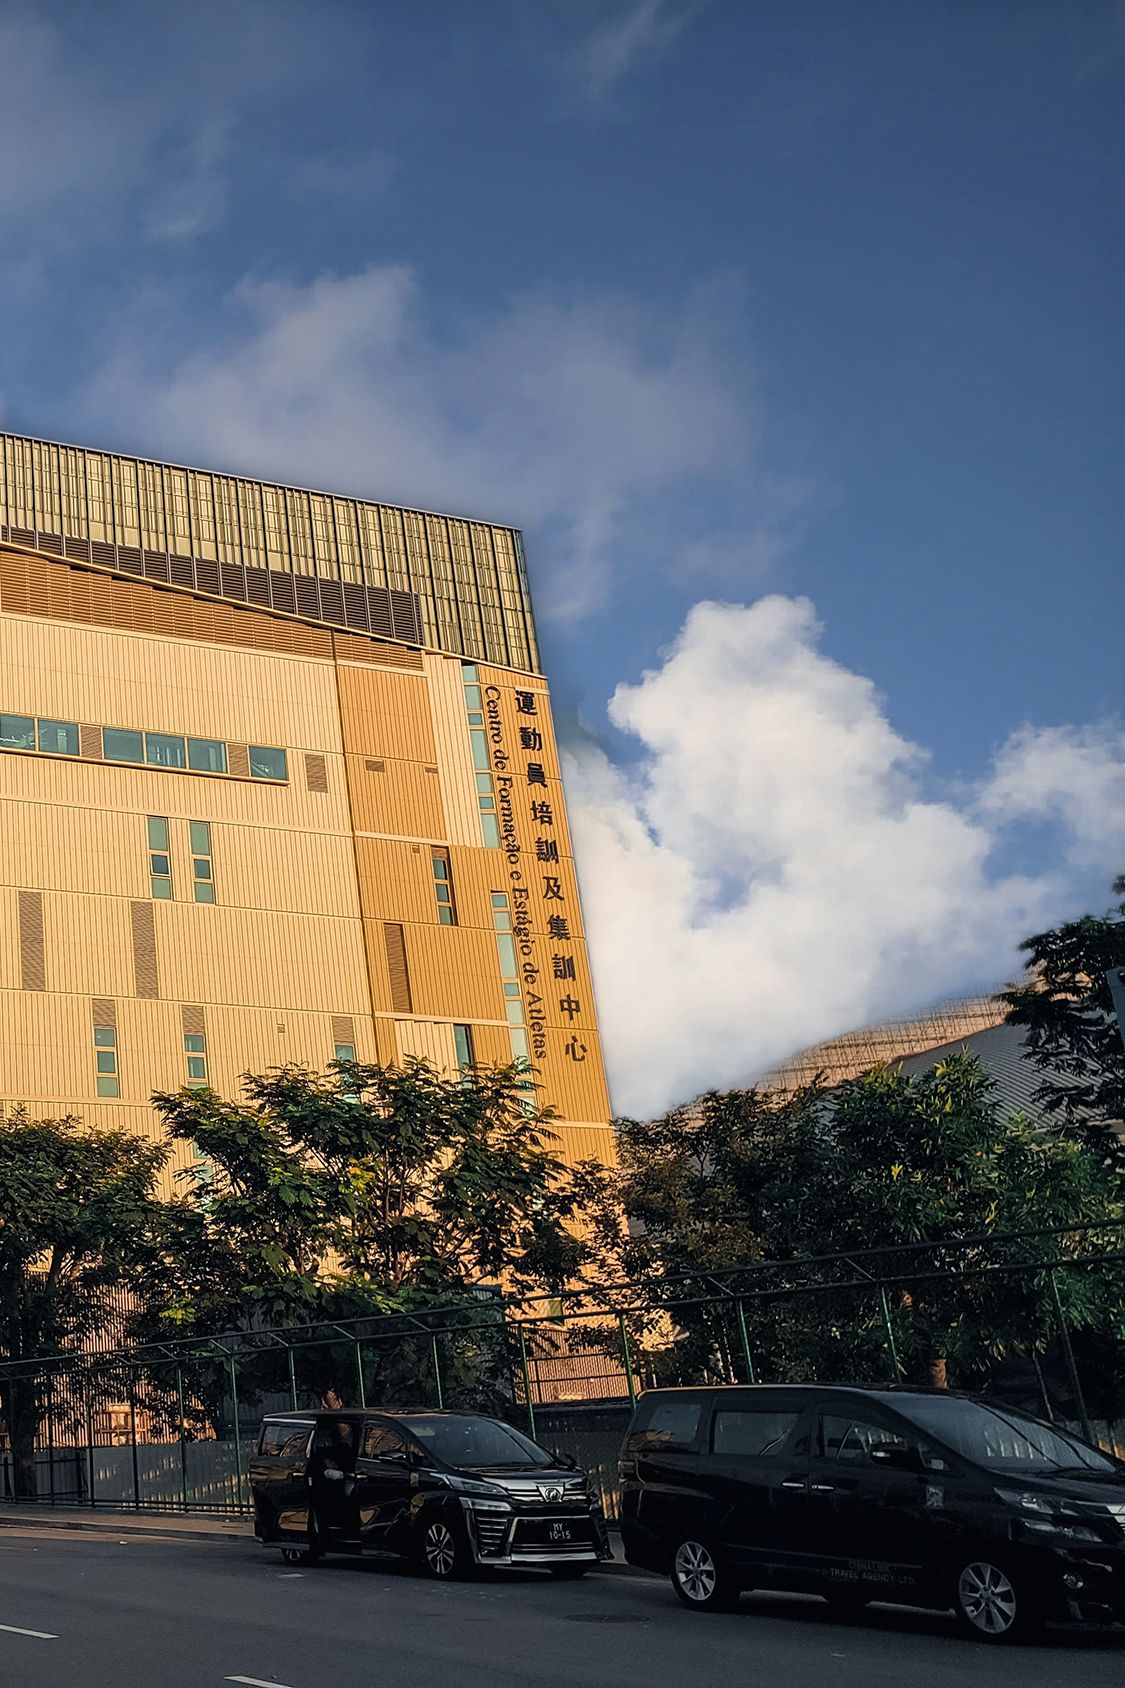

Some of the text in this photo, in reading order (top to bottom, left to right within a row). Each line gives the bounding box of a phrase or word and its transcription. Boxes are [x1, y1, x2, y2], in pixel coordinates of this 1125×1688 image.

[485, 685, 547, 1060] Centro de Formação e Estágio de Atletas
[515, 689, 588, 1062] 運動員培訓及集訓中心
[549, 1530, 571, 1540] 10-15
[829, 1567, 859, 1579] TRAVEL
[862, 1571, 894, 1582] AGENCY
